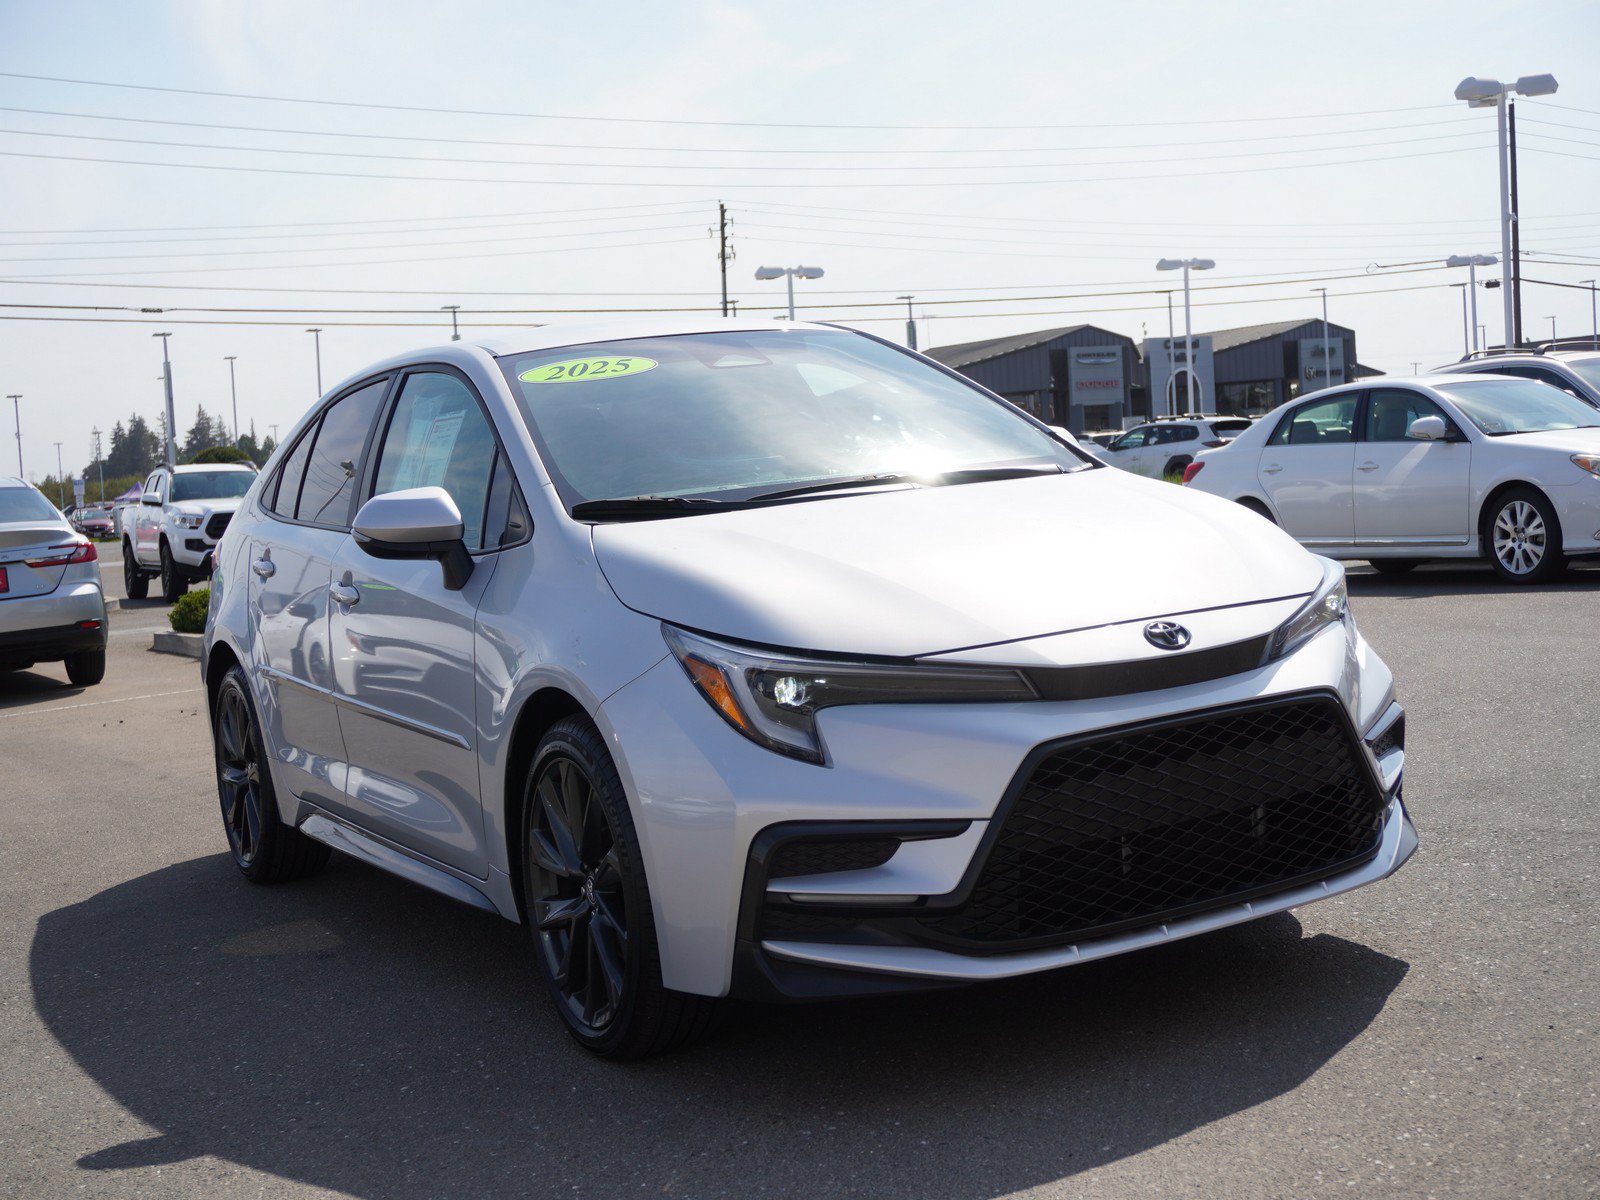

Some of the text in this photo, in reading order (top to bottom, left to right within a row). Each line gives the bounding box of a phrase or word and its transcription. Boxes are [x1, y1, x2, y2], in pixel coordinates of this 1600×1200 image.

[1163, 339, 1200, 349] Cental
[1167, 352, 1197, 364] Vally
[544, 358, 632, 381] 2025
